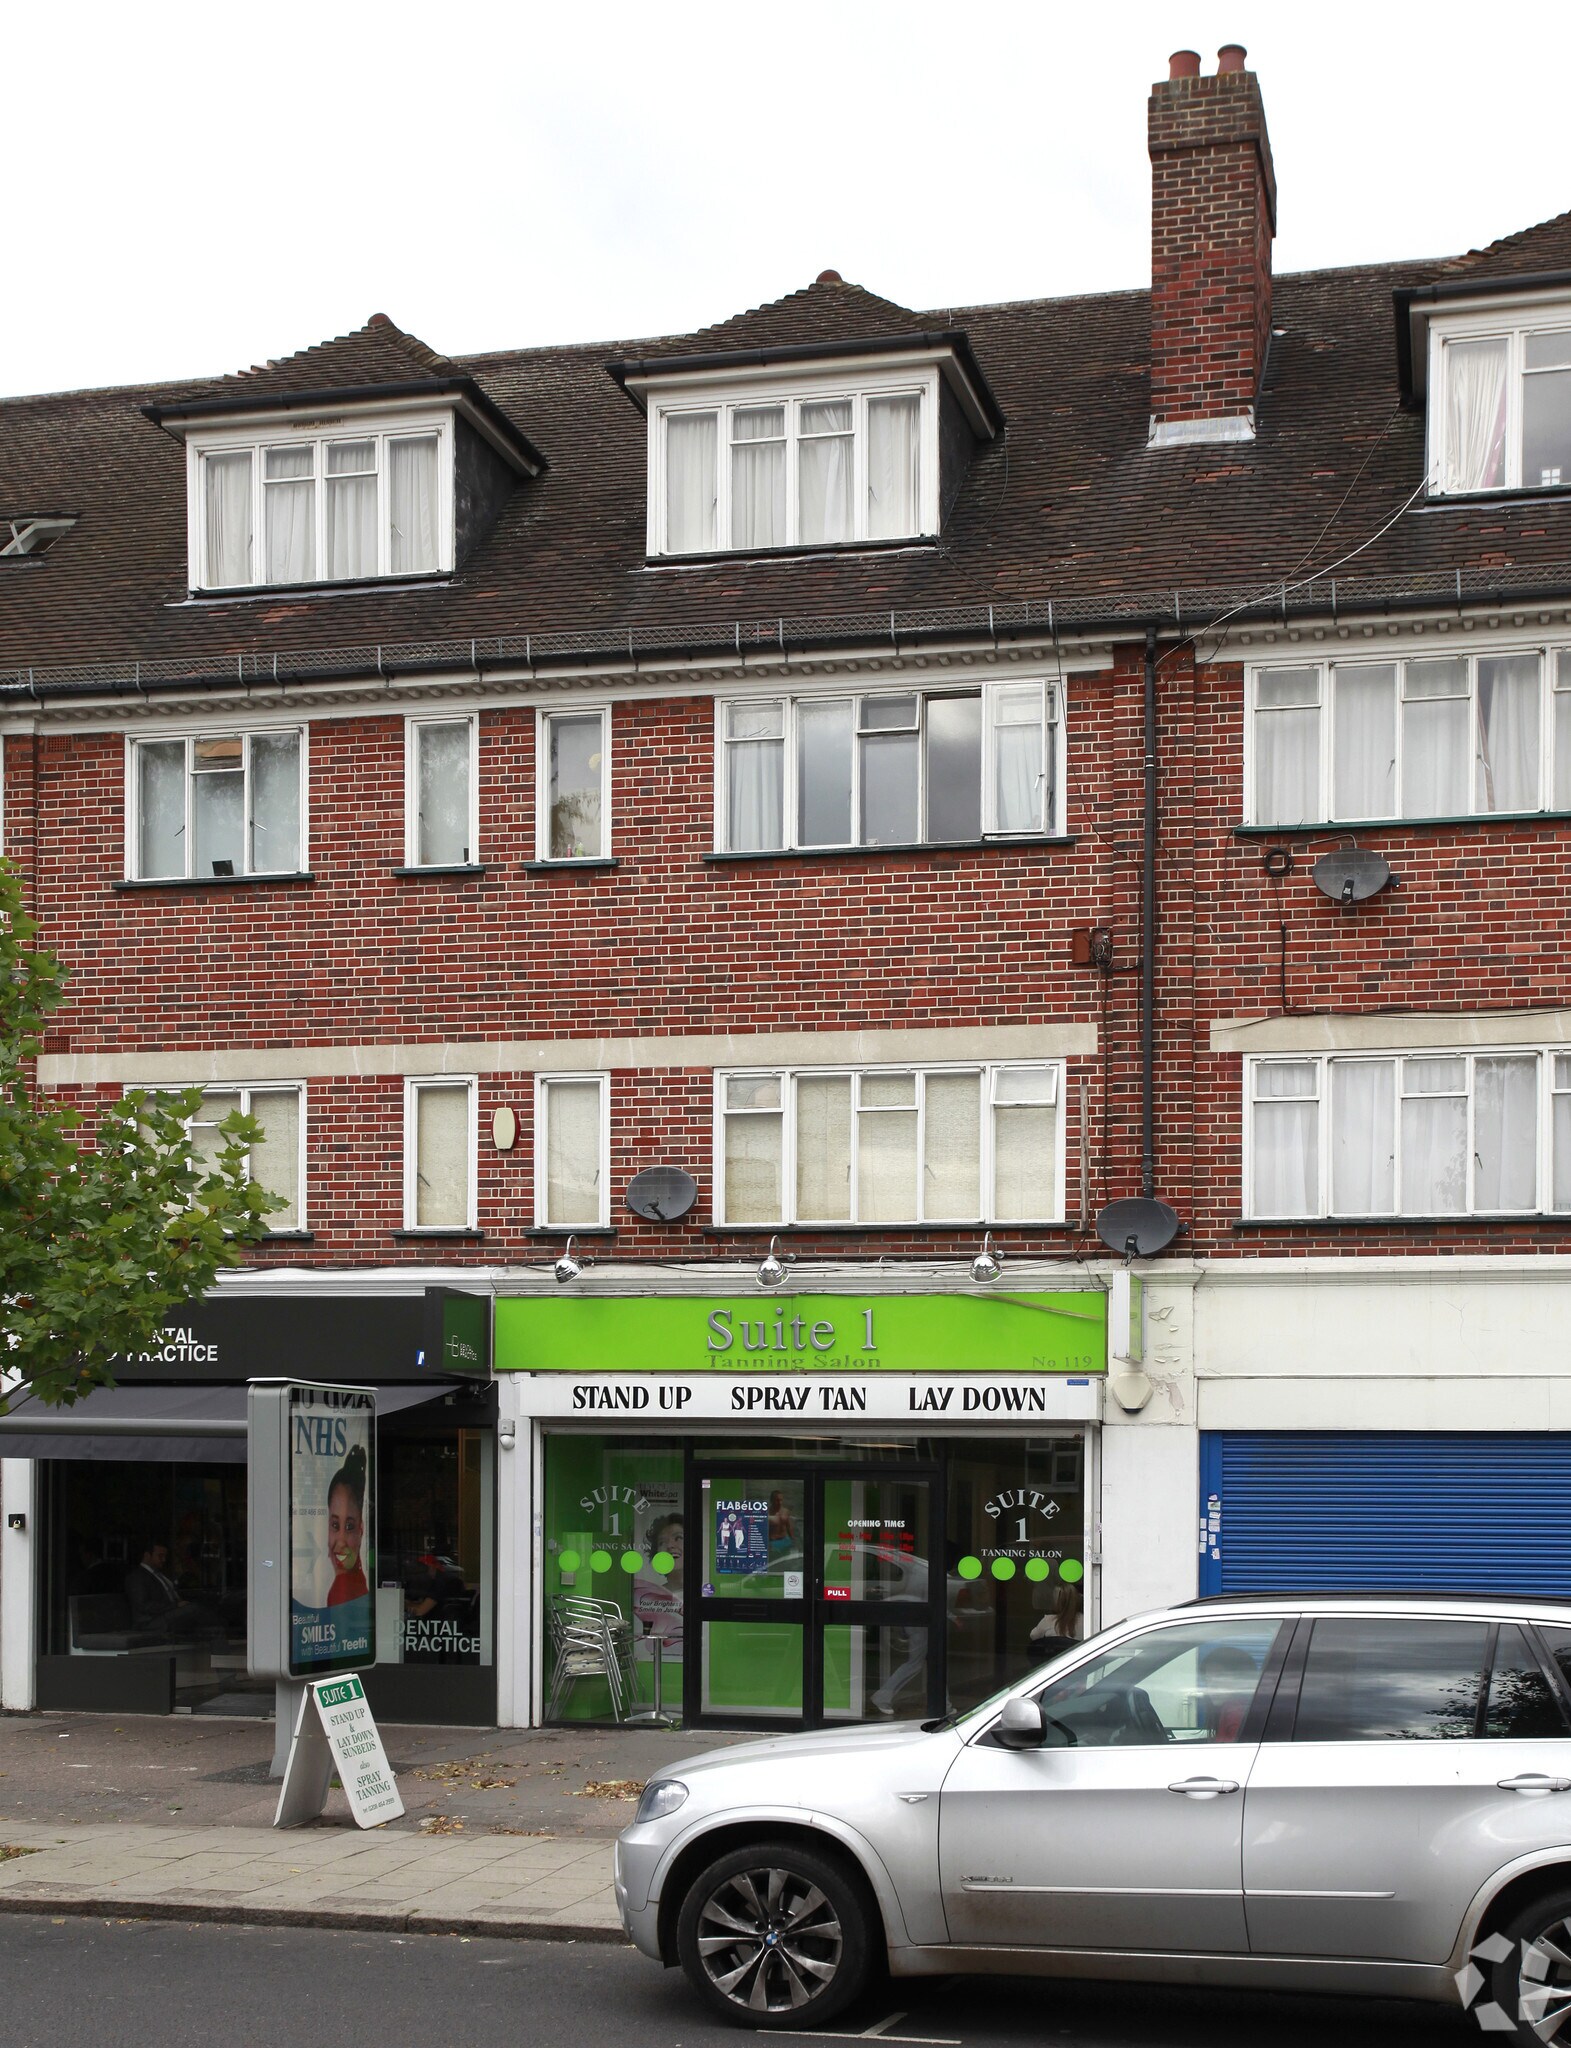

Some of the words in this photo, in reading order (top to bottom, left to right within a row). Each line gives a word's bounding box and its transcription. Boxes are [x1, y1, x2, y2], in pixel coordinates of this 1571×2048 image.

[707, 1307, 836, 1351] Suite
[704, 1354, 805, 1371] Tanning
[813, 1354, 881, 1368] Salon
[1032, 1356, 1056, 1368] No
[1065, 1355, 1093, 1368] 119
[572, 1385, 650, 1409] STAND
[659, 1386, 692, 1410] UP
[731, 1386, 811, 1411] SPRAY
[818, 1387, 867, 1410] TAN
[909, 1387, 954, 1411] LAY
[962, 1387, 1046, 1411] DOWN
[294, 1415, 347, 1457] NHS
[580, 1485, 651, 1515] SUITE
[716, 1500, 768, 1511] FLABéLOS
[984, 1489, 1060, 1520] SUITE
[609, 1512, 623, 1537] 1
[847, 1520, 881, 1528] OPENING
[884, 1520, 906, 1528] TIMES
[1015, 1517, 1030, 1542] 1
[621, 1543, 652, 1551] SALON
[981, 1548, 1026, 1558] TANNING
[1028, 1549, 1063, 1558] SALON
[827, 1589, 847, 1597] PULL
[292, 1614, 320, 1625] Beautiful
[393, 1619, 463, 1636] DENTAL
[301, 1624, 336, 1644] SMILES
[342, 1636, 368, 1651] Teeth
[393, 1636, 480, 1653] PRACTICE
[322, 1686, 347, 1705] SUITE
[345, 1680, 360, 1700] 1
[330, 1711, 355, 1727] STAND
[355, 1708, 365, 1720] UP
[349, 1722, 356, 1733] &
[336, 1735, 353, 1749] LAY
[351, 1729, 375, 1744] DOWN
[342, 1740, 377, 1759] SUNBEDS
[356, 1770, 383, 1788] SPRAY
[356, 1780, 391, 1801] TANNING
